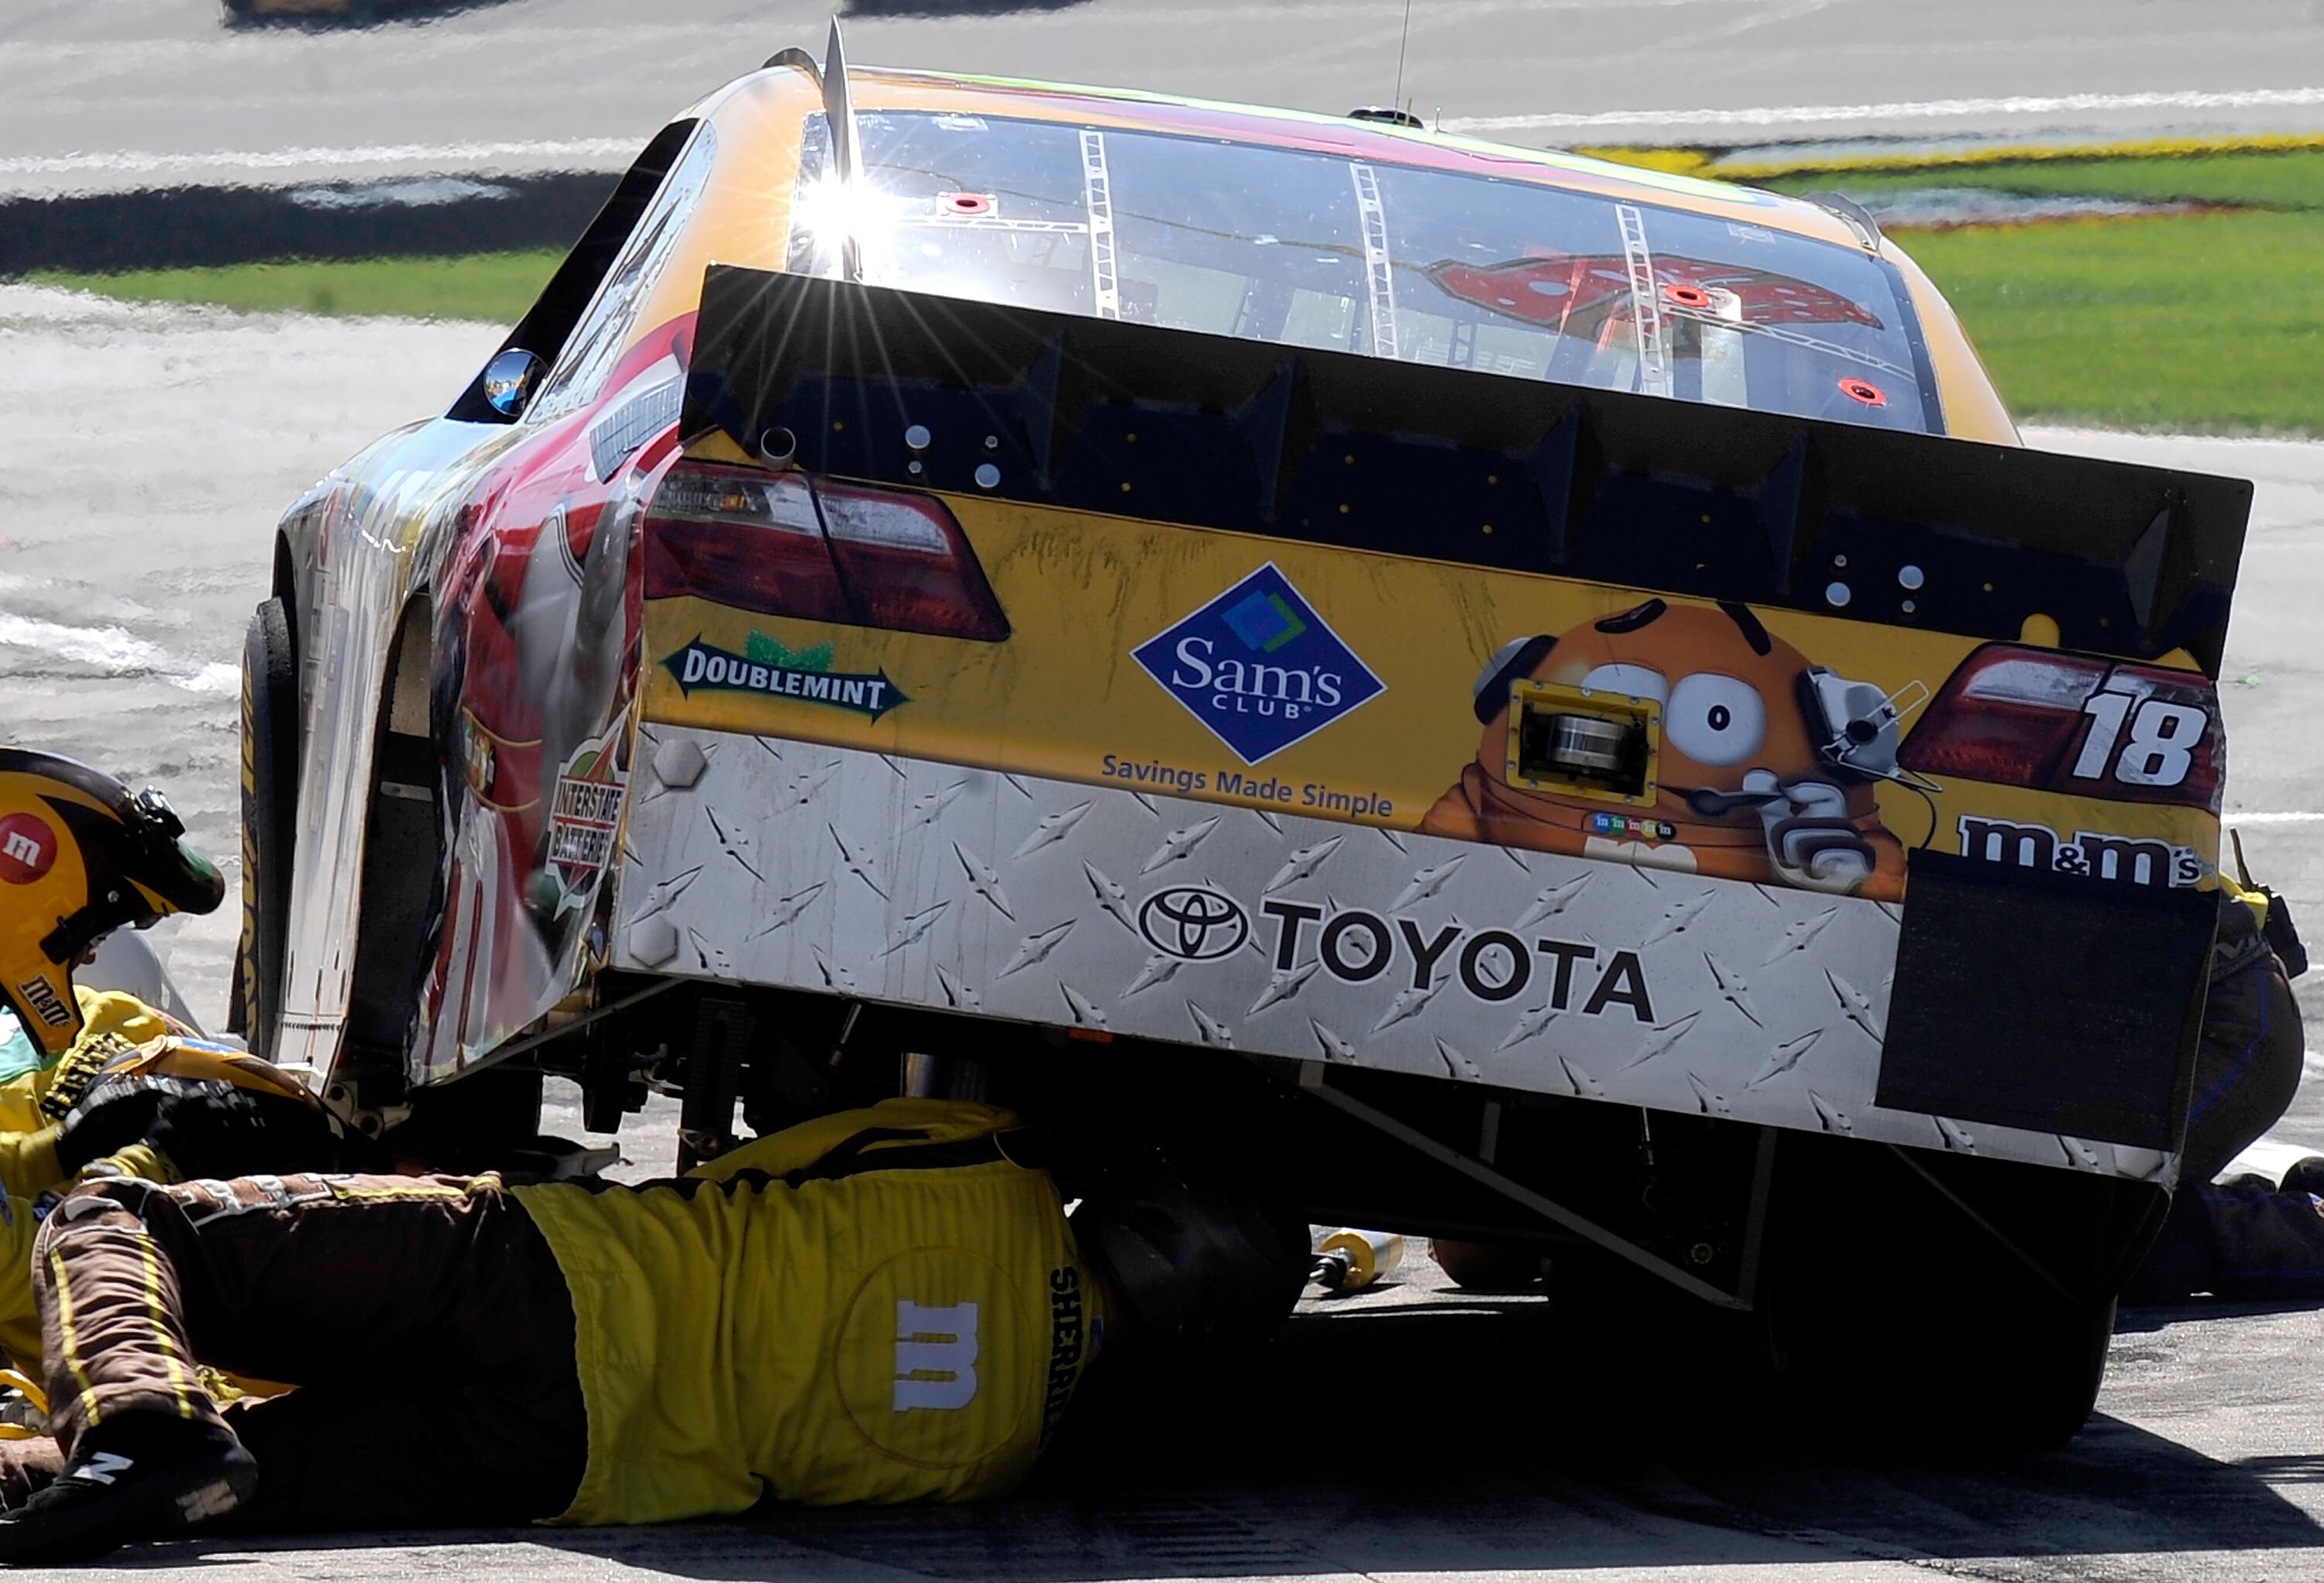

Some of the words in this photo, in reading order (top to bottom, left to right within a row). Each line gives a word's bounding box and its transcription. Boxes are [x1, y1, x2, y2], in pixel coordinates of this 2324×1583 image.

[682, 649, 886, 709] DOUBLEMINT
[1172, 637, 1342, 706] Sam's
[1212, 694, 1300, 719] CLUB
[2072, 689, 2208, 787] 18
[1102, 754, 1206, 792] Savings
[1216, 771, 1293, 802] Made
[1302, 784, 1394, 818] Simple
[2, 830, 41, 867] m
[1262, 901, 1655, 1023] TOYOTA
[892, 1300, 979, 1413] m
